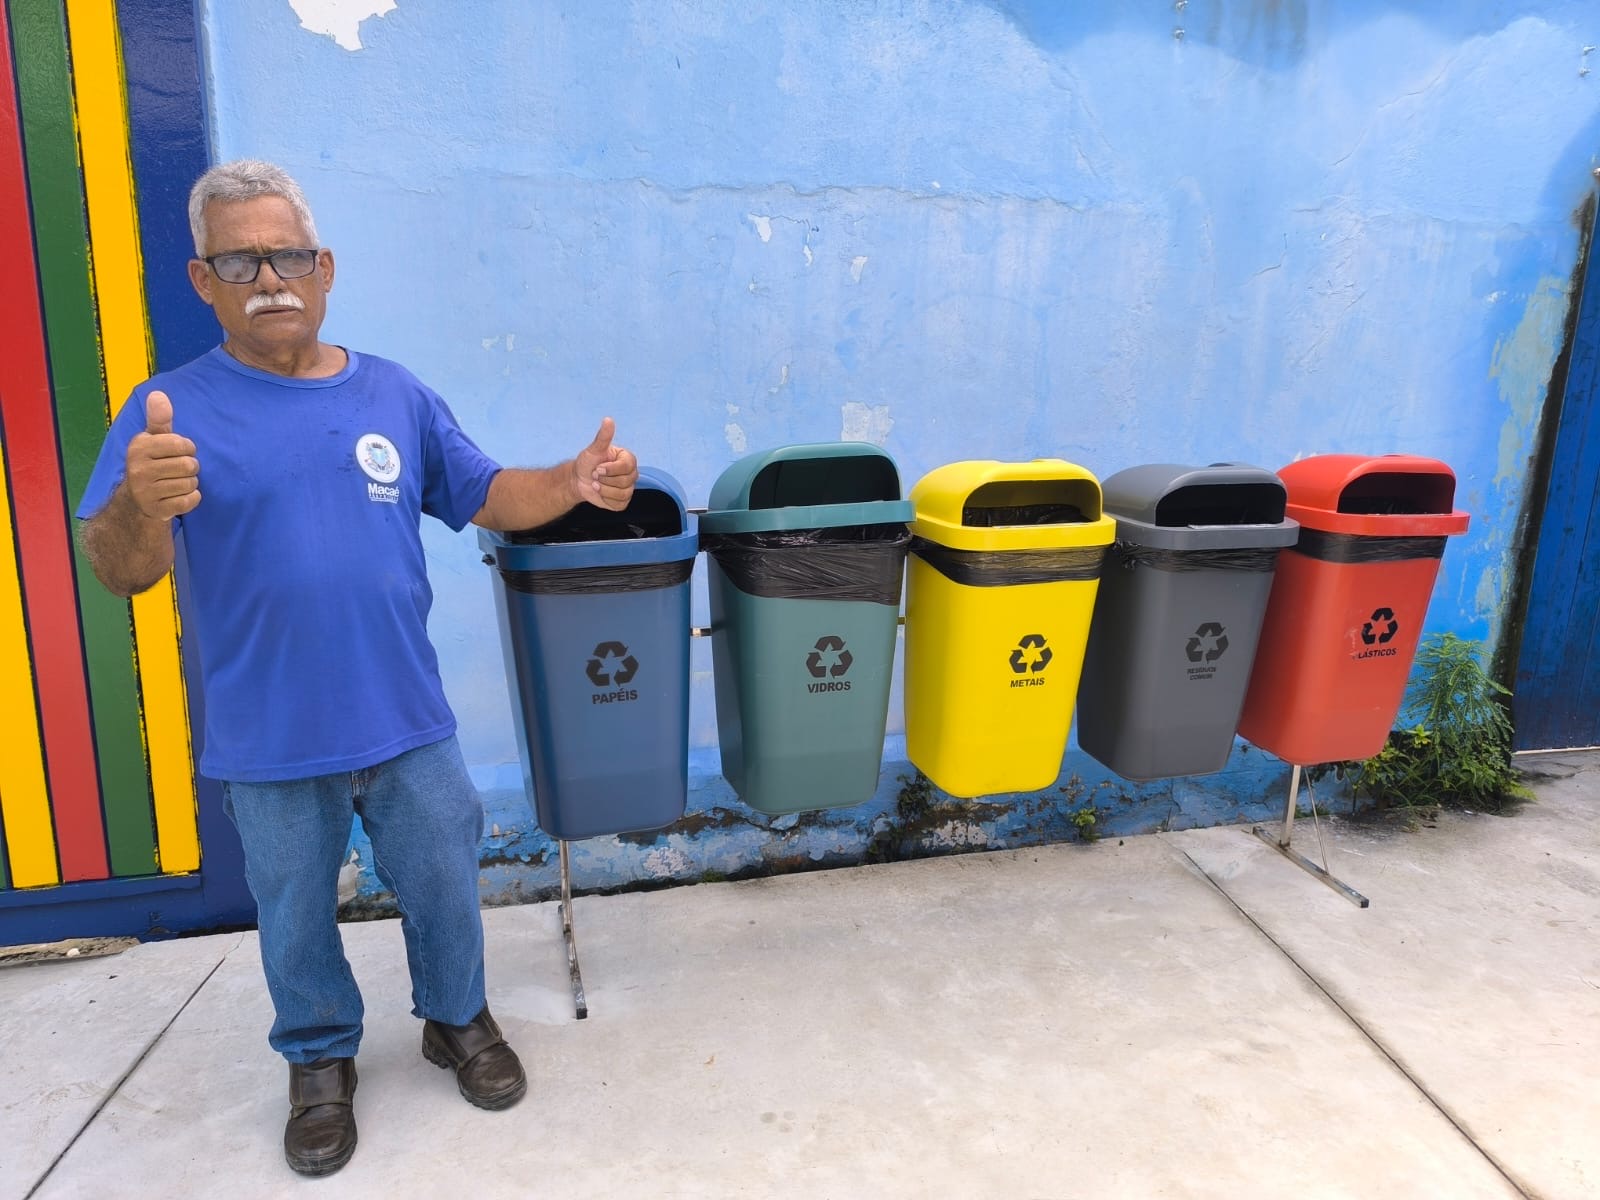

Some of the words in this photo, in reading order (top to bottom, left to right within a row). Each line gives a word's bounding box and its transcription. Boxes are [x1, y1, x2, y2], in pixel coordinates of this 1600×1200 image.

[367, 482, 400, 497] Macaé
[1352, 648, 1397, 660] LÁSTICOS
[807, 681, 851, 693] VIDROS
[1010, 677, 1045, 688] METAIS
[592, 688, 638, 704] PAPÉIS
